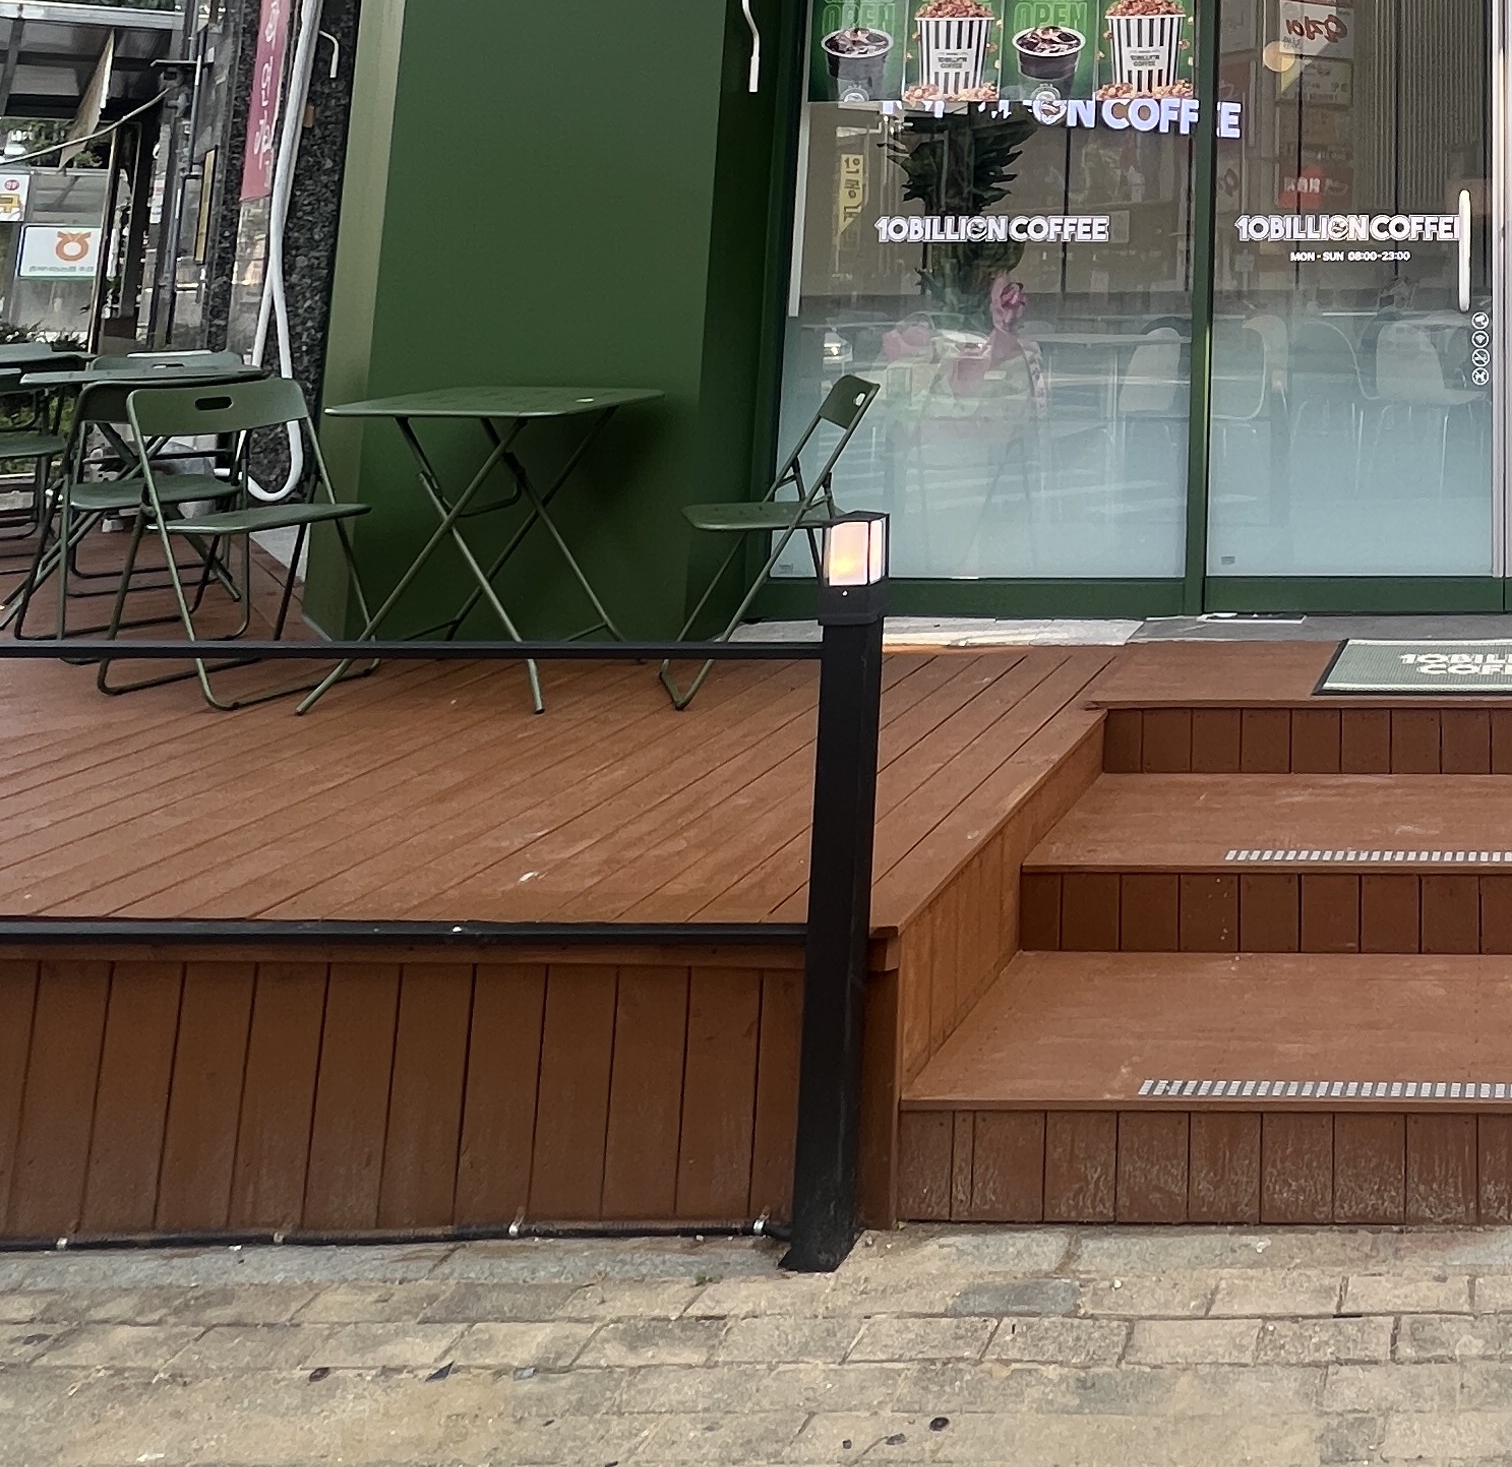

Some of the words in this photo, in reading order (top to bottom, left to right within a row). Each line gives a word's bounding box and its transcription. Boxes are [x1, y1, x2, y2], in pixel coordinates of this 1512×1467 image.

[1102, 98, 1241, 139] COFFE
[874, 215, 1008, 243] 10BILLION
[1009, 215, 1110, 243] COFFEE
[1234, 214, 1369, 242] 10BILLION
[1290, 251, 1316, 262] MON
[1322, 251, 1345, 262] SUN
